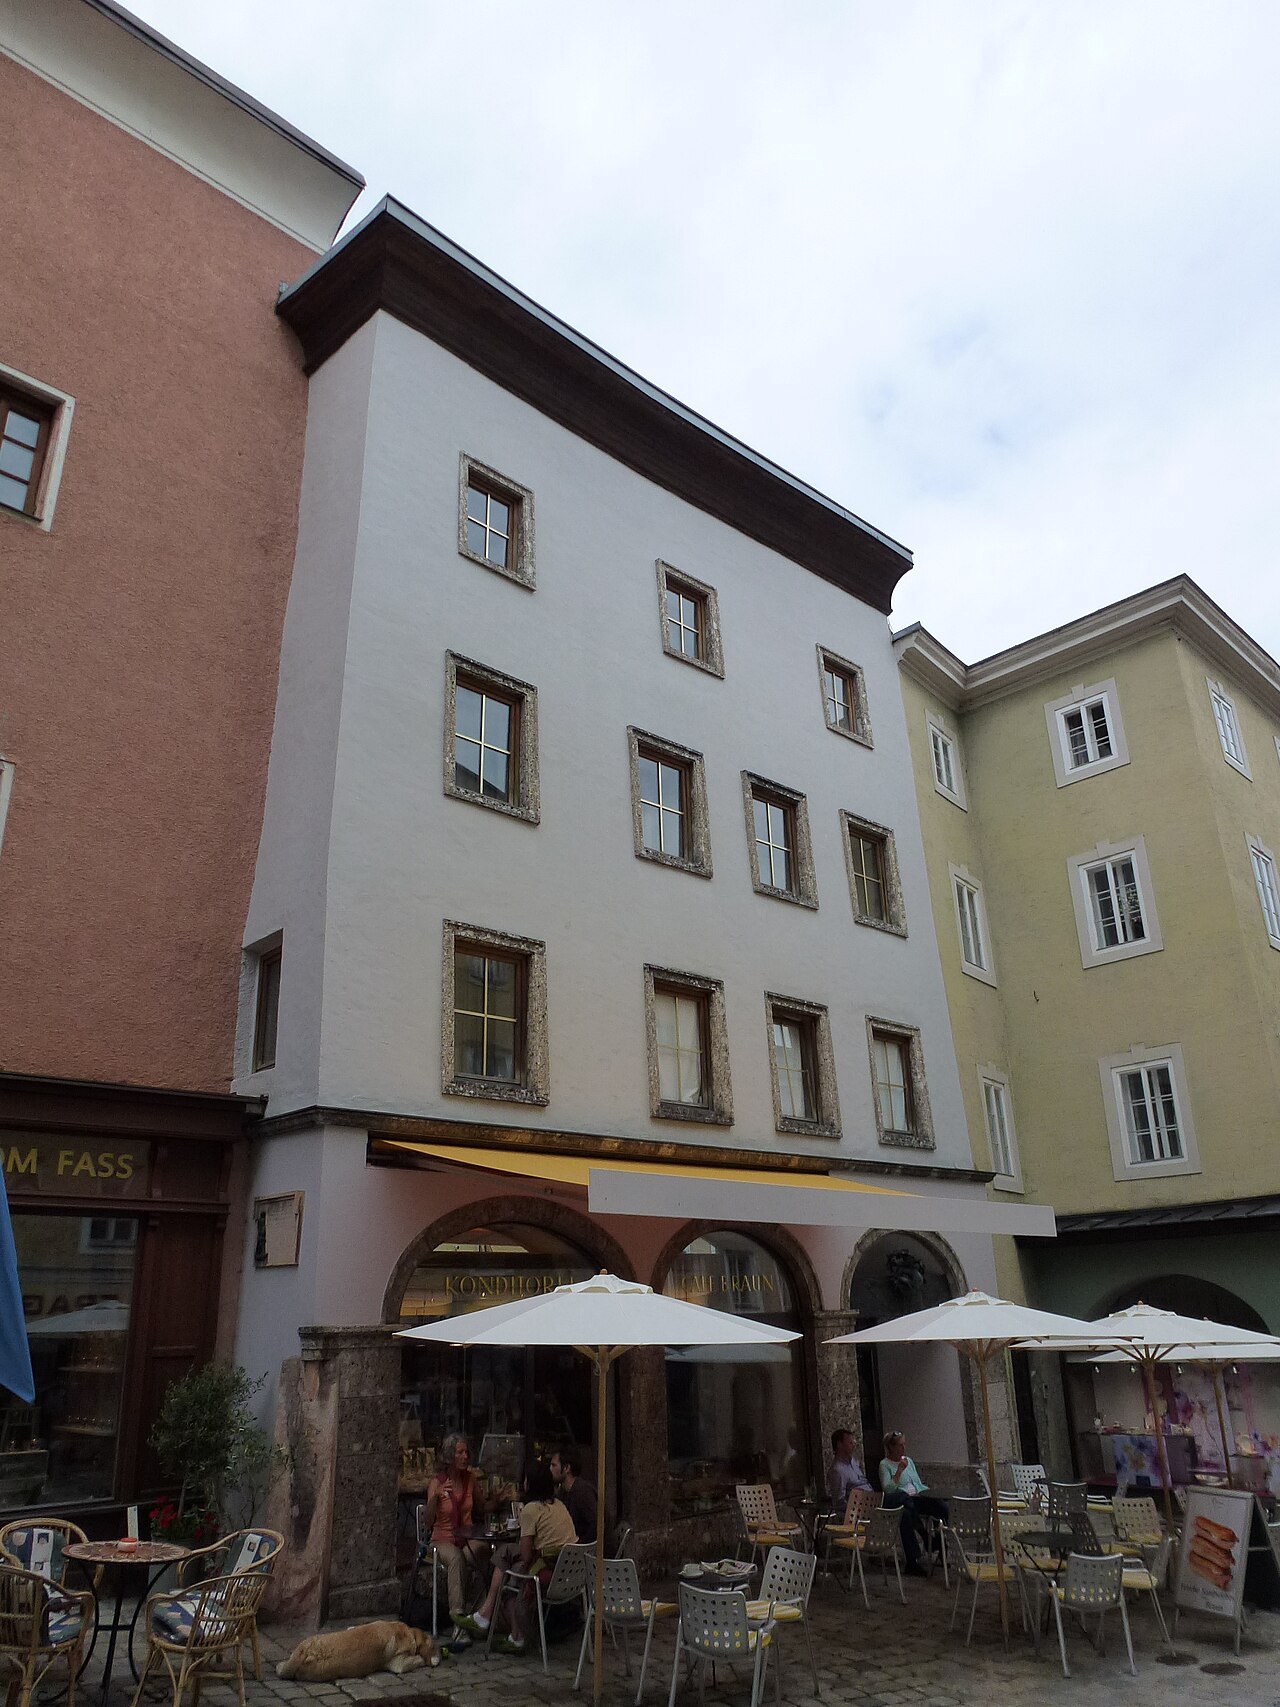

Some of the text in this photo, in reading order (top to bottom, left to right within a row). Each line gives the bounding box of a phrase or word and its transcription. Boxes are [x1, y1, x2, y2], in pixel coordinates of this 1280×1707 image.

[0, 1146, 134, 1179] M FASS
[721, 1274, 774, 1293] BRAUN
